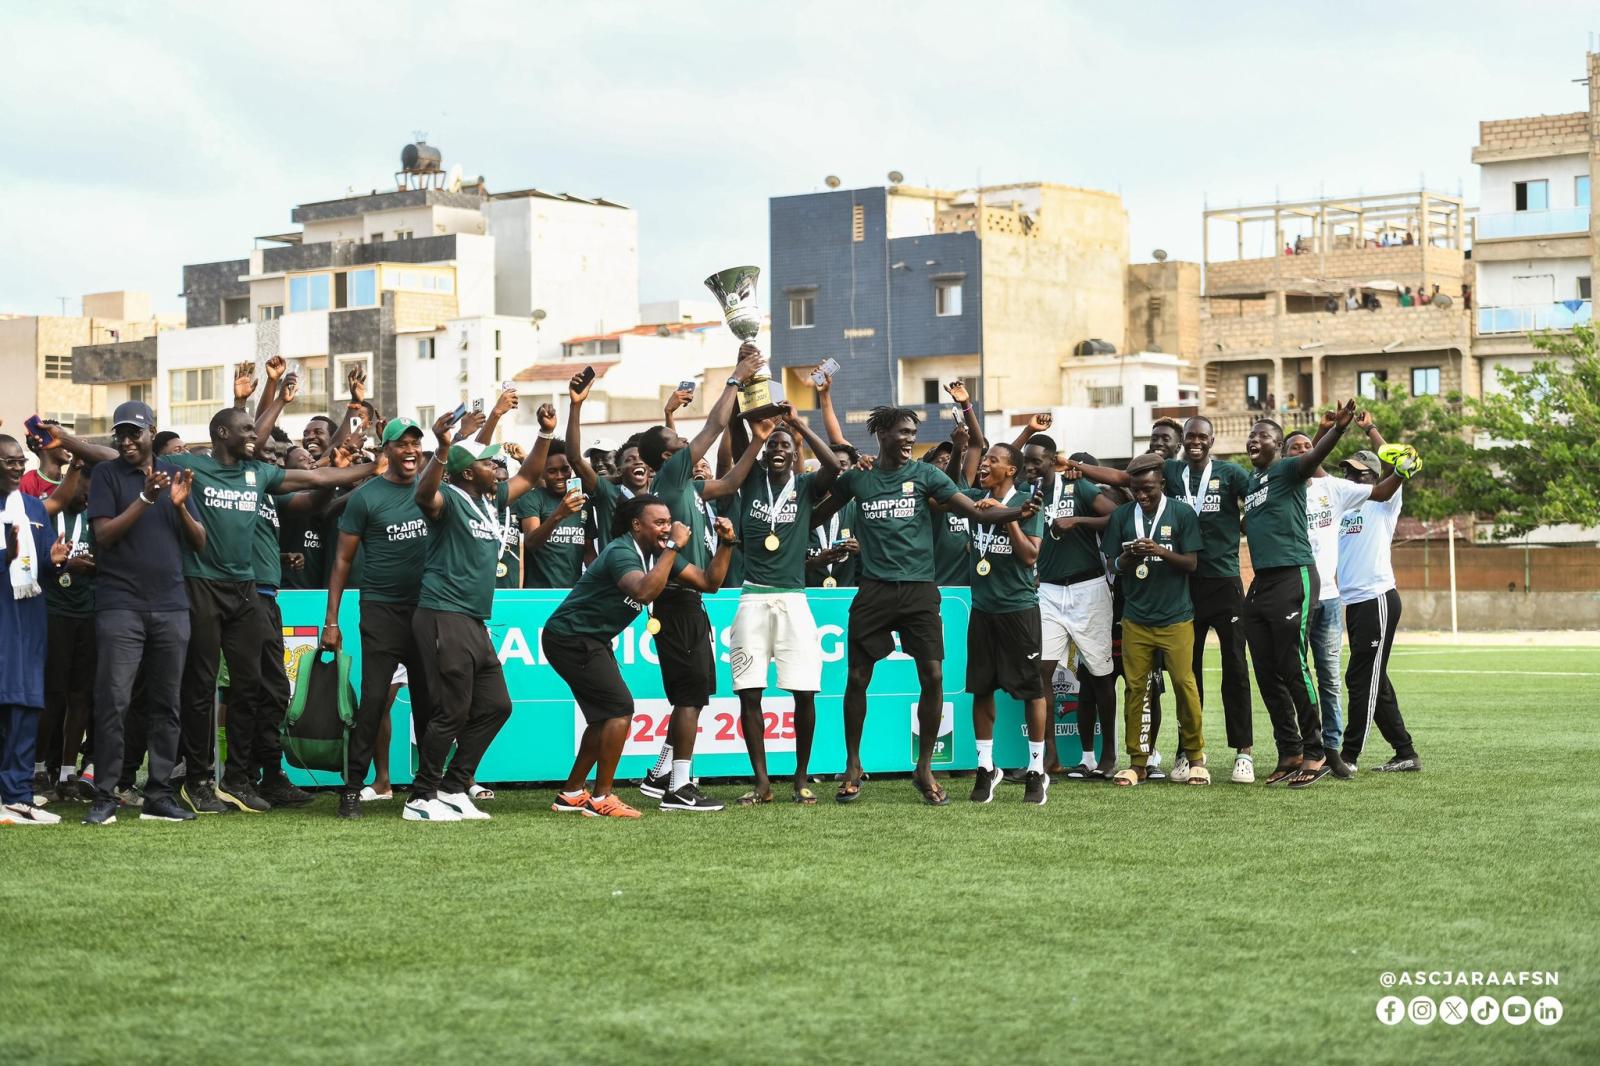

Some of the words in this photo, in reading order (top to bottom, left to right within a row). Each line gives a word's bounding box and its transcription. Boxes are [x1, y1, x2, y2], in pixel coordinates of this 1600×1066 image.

[205, 498, 233, 509] LIGUE
[894, 507, 915, 518] 2025
[388, 530, 417, 541] LIGUE
[991, 544, 1013, 554] 2025
